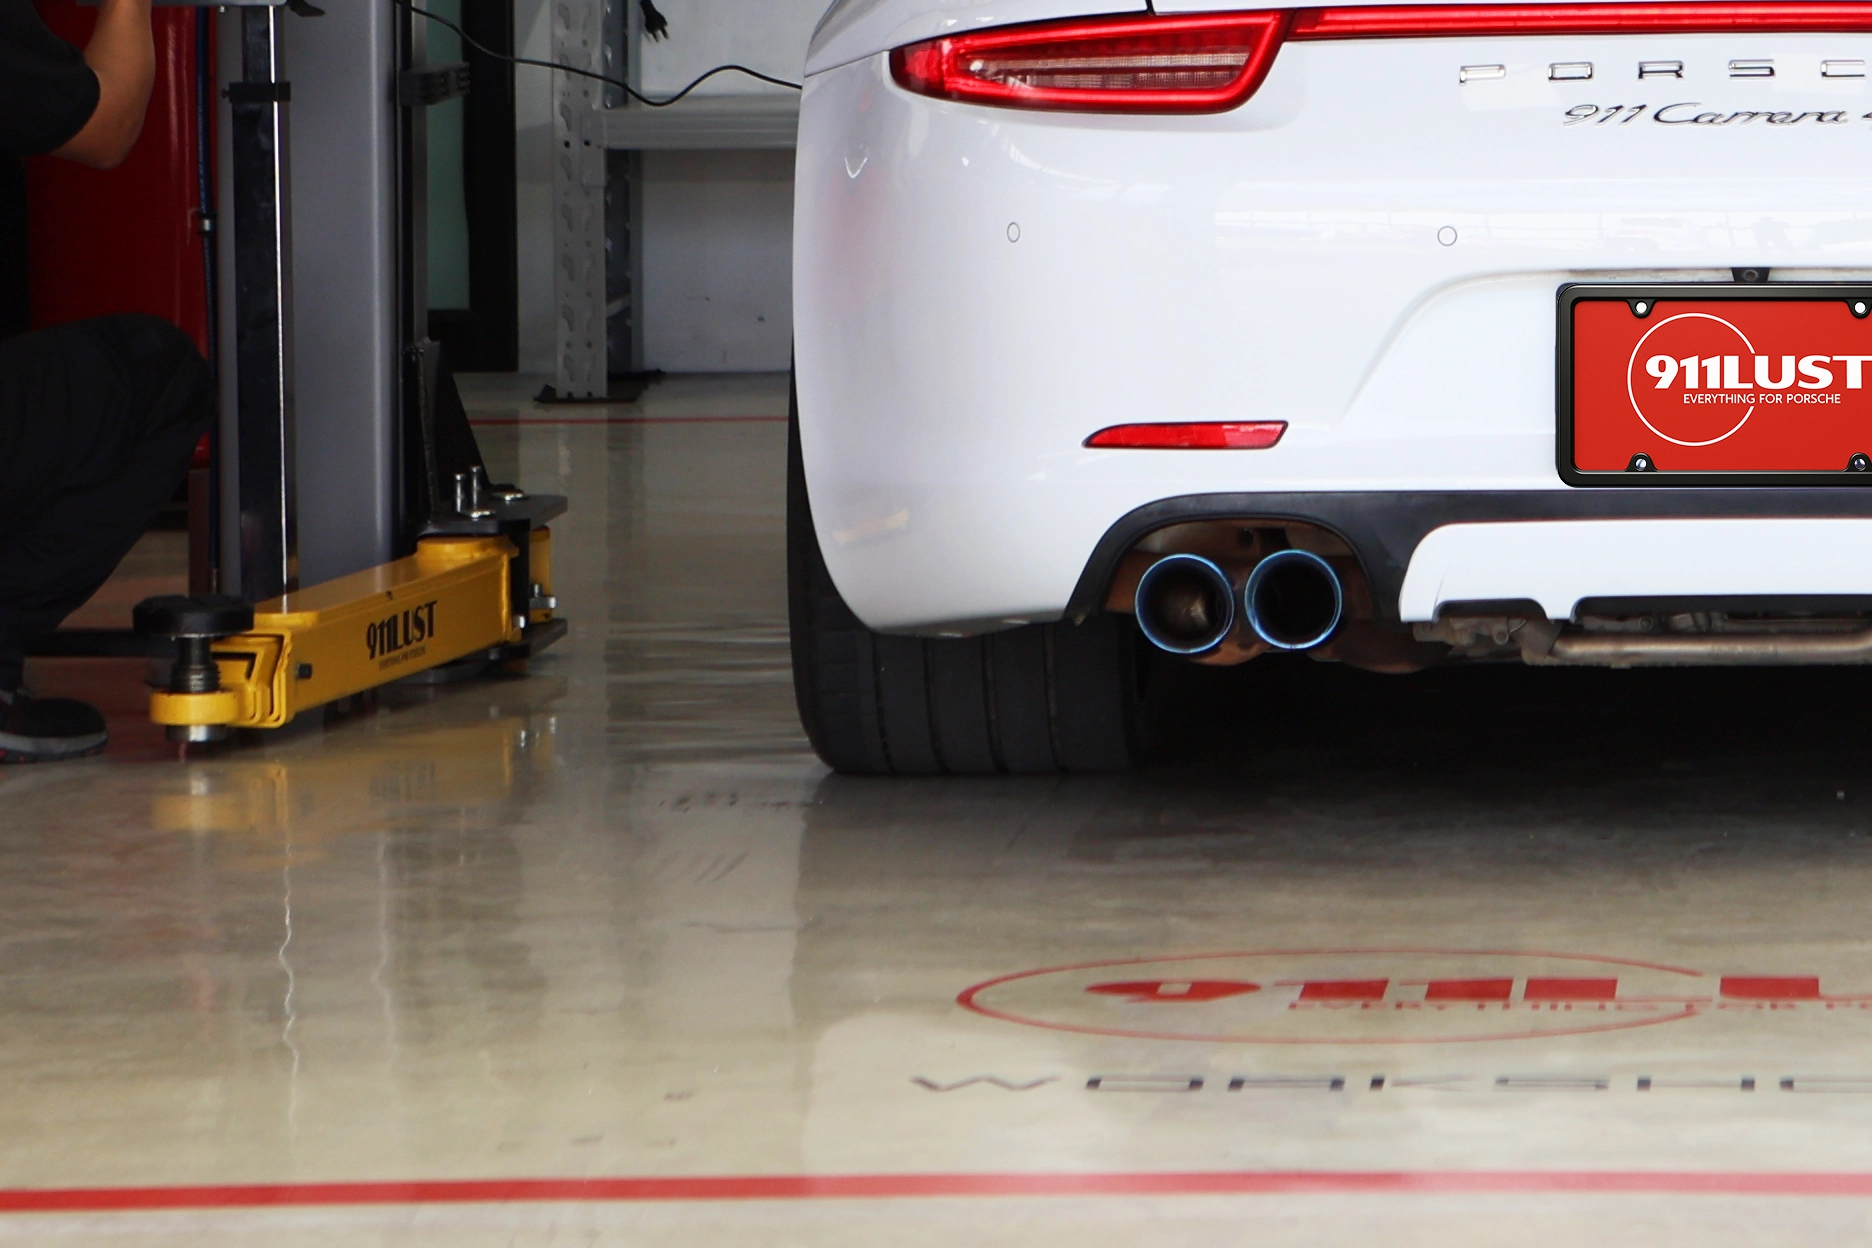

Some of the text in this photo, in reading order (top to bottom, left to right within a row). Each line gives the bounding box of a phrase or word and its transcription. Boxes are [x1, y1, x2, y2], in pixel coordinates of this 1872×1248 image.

[1563, 104, 1647, 129] 911
[1652, 102, 1848, 127] Carrera
[1684, 393, 1841, 404] EVERYTHING FOR PORSCHE
[366, 600, 439, 661] 911LUST
